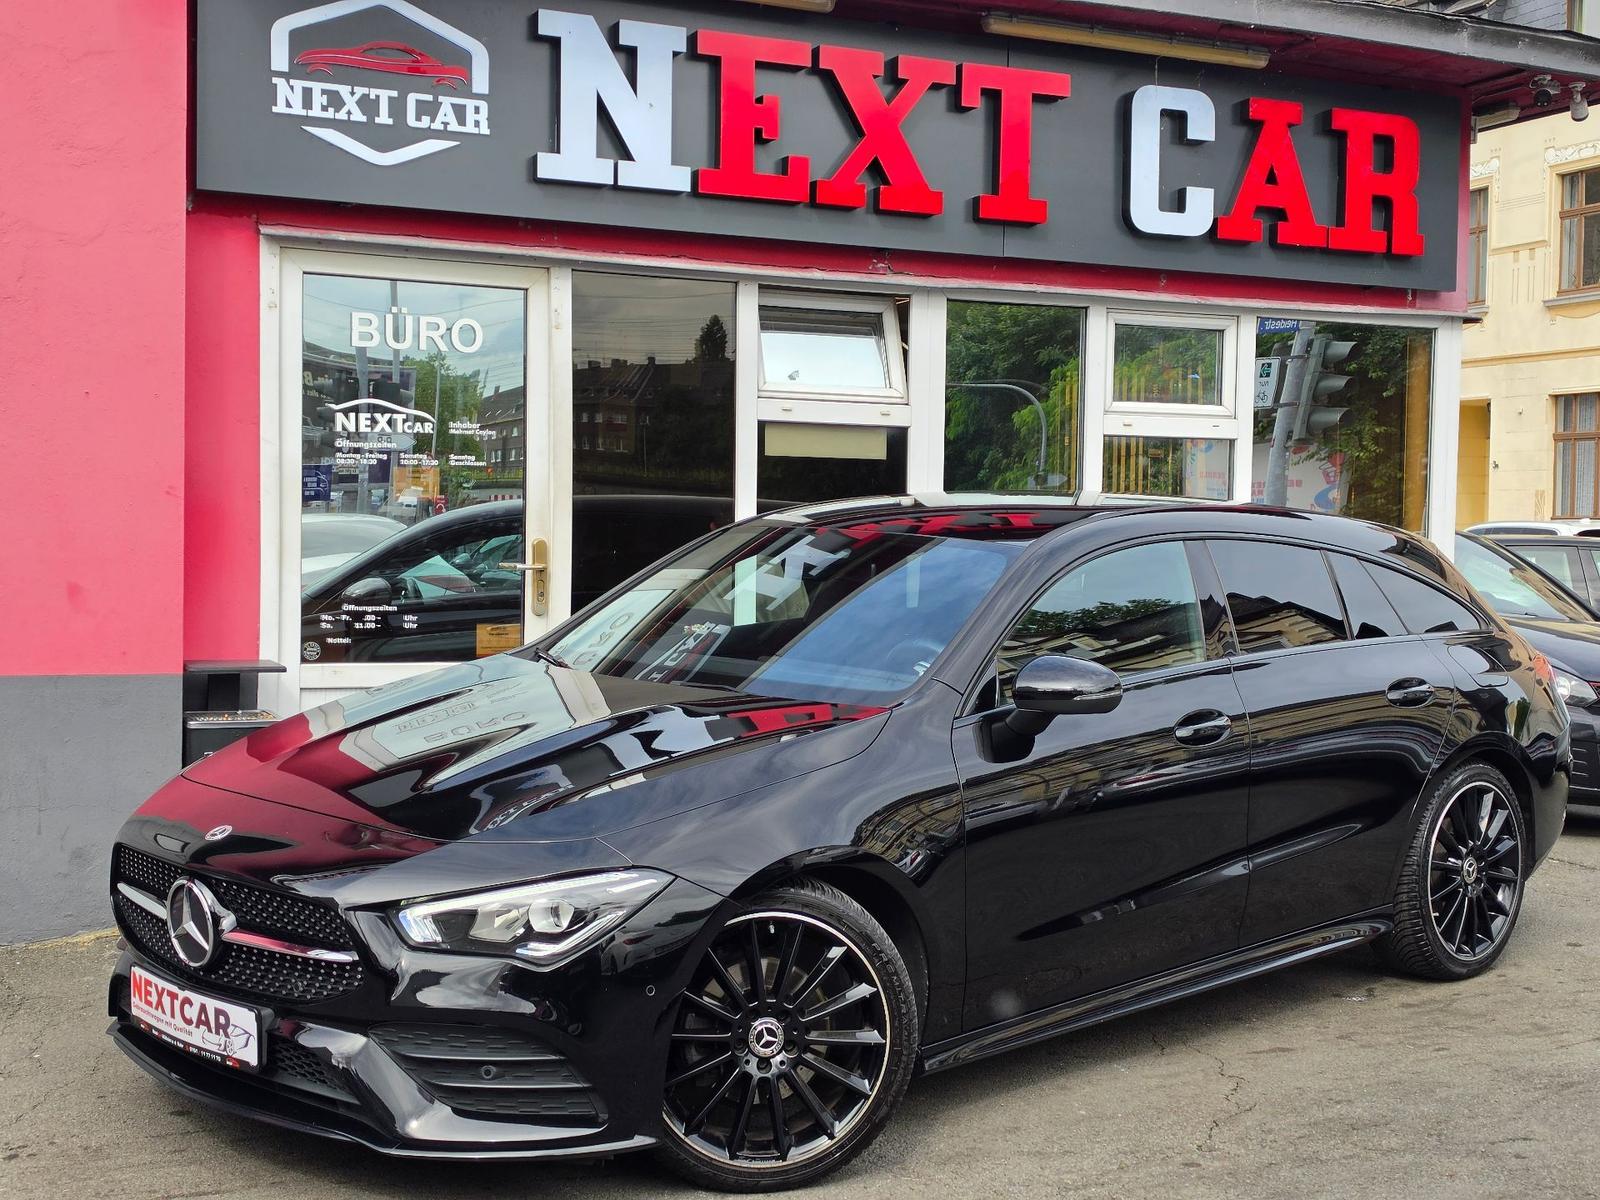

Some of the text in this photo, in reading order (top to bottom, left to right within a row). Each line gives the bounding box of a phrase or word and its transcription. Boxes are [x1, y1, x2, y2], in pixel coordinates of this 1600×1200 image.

[271, 76, 491, 136] NEXT CAR
[534, 7, 1425, 257] NEXT CAR
[351, 307, 484, 353] BÜRO
[334, 438, 397, 449] Öffnungszeiten
[335, 452, 361, 460] Montag
[365, 452, 388, 460] Freitag
[342, 603, 398, 612] Öffnungszeiten
[132, 970, 231, 1039] NEXTCAR
